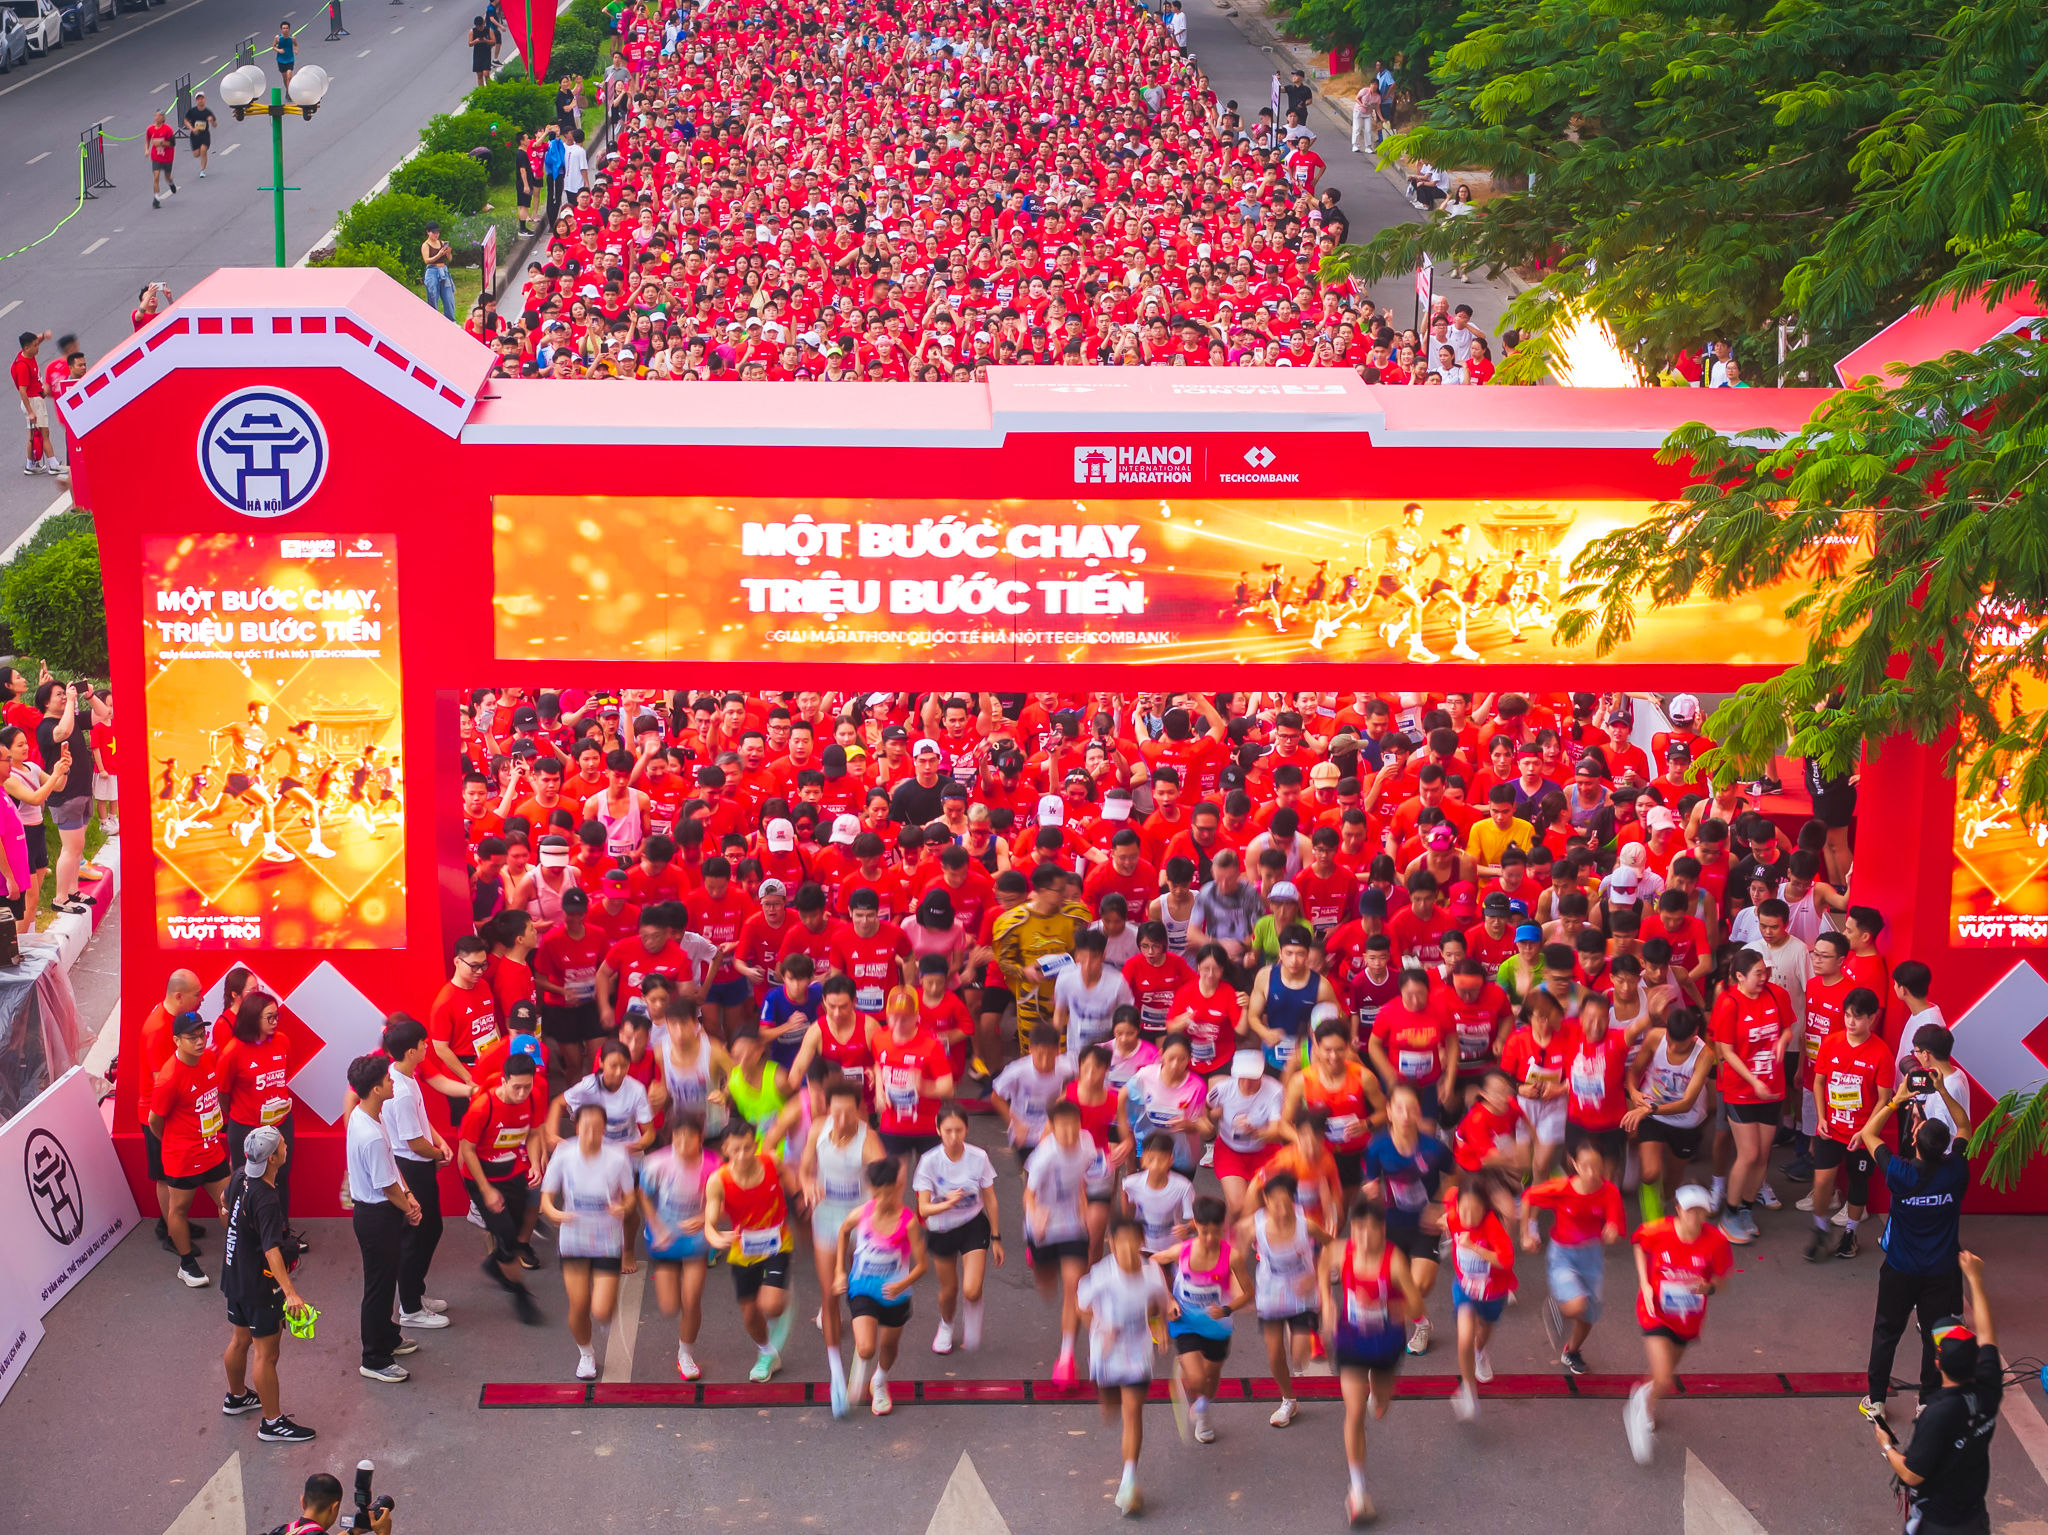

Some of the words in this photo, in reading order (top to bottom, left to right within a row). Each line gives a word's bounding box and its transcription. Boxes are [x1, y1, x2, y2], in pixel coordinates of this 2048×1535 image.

[1119, 446, 1192, 464] HANOI
[1119, 472, 1192, 482] MARATHON
[1219, 473, 1299, 483] TECHCOMBANK
[247, 498, 261, 511] HÀ
[264, 498, 282, 513] NỘI
[742, 514, 850, 565] MỘT
[858, 515, 999, 558] BƯỚC
[1006, 524, 1146, 567] CHẠY,
[157, 585, 215, 616] MỘT
[222, 585, 298, 611] BƯỚC
[303, 590, 381, 615] CHẠY,
[740, 570, 881, 621] TRIỆU
[890, 571, 1031, 614] BƯỚC
[1036, 572, 1144, 614] TIẾN
[157, 616, 234, 647] TRIỆU
[240, 617, 317, 643] BƯỚC
[322, 615, 381, 642] TIẾN
[810, 630, 905, 643] MARATHON
[168, 923, 218, 941] VƯỢT
[220, 923, 261, 941] TRỘI
[1958, 922, 2006, 940] VƯỢT
[2008, 922, 2048, 940] TRỘI
[472, 1019, 481, 1035] 5
[256, 1073, 267, 1091] 5
[1831, 1071, 1843, 1085] 5
[194, 1095, 204, 1112] 5
[1904, 1193, 1953, 1206] MEDIA
[75, 1252, 88, 1269] THAO
[92, 1240, 100, 1252] DU
[226, 1227, 237, 1266] EVENT
